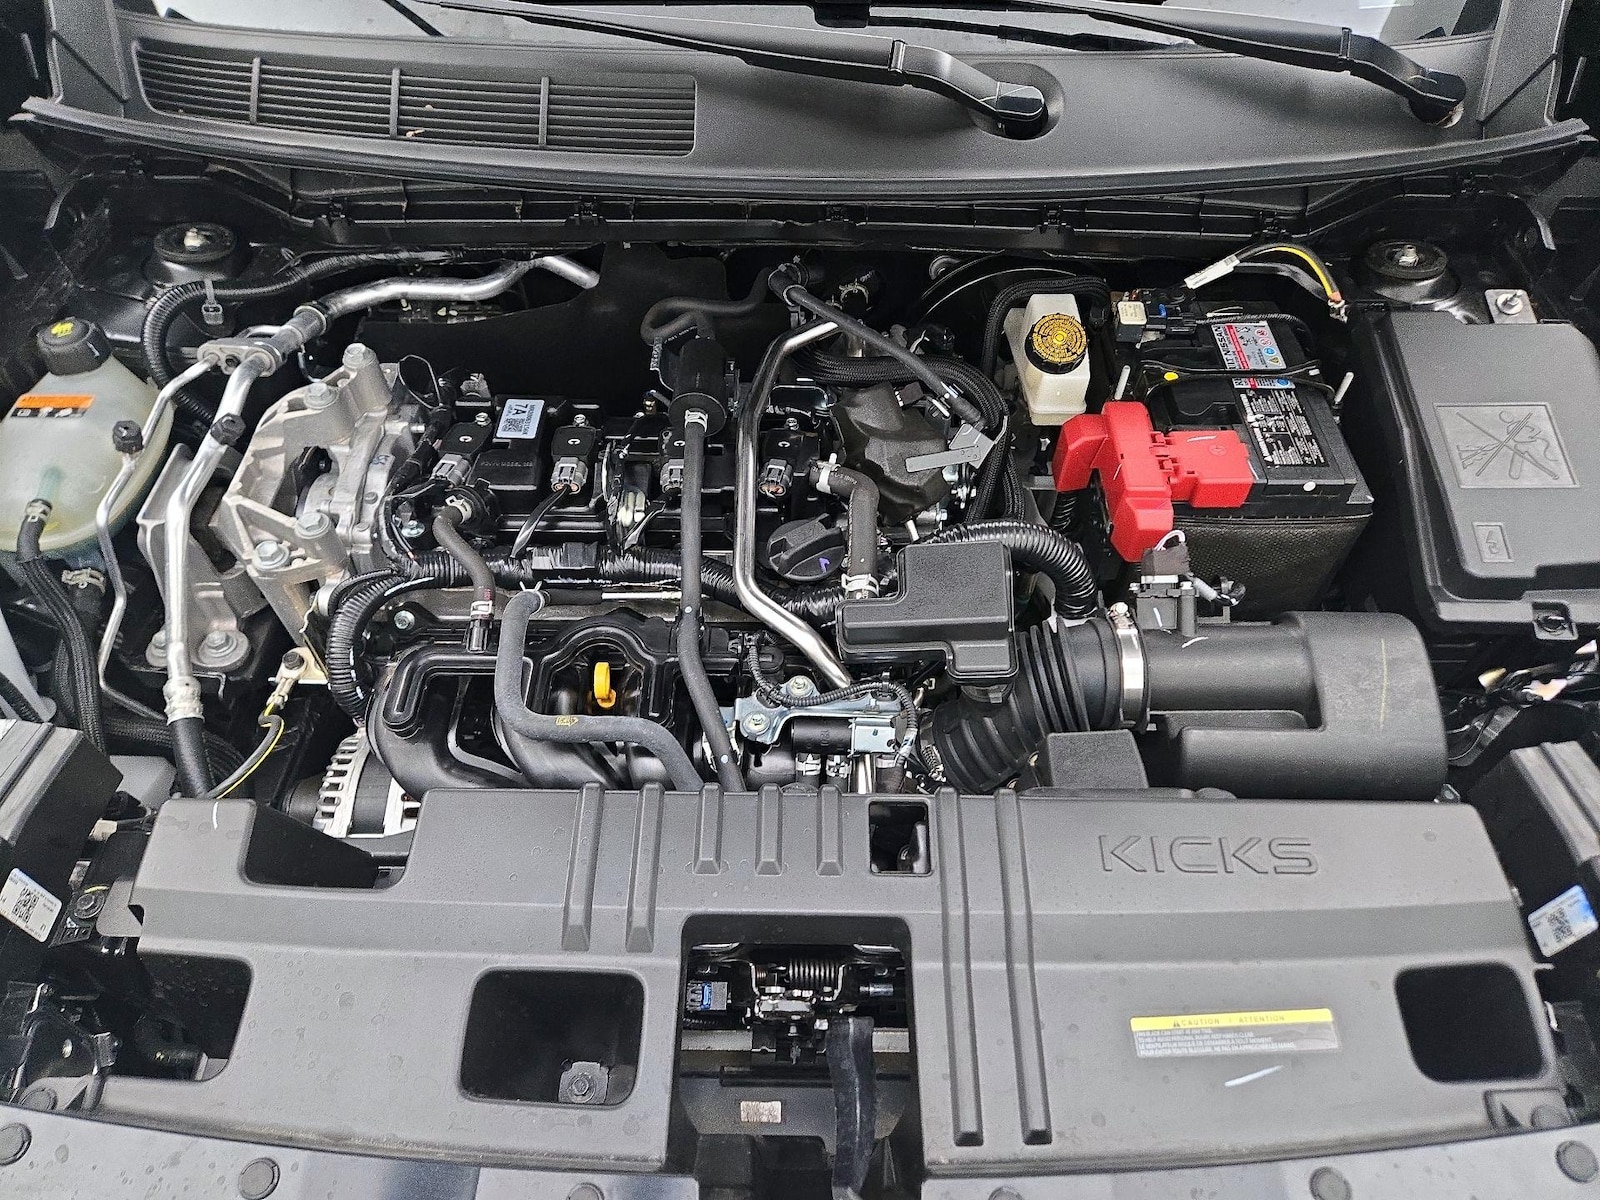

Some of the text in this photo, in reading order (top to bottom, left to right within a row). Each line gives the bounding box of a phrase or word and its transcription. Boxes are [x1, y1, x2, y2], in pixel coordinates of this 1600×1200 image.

[1213, 325, 1230, 356] NISSAN
[512, 404, 528, 415] 7A
[1099, 835, 1318, 874] KICKS
[1181, 1017, 1220, 1026] CAUTION
[1238, 1014, 1284, 1023] ATTENTION
